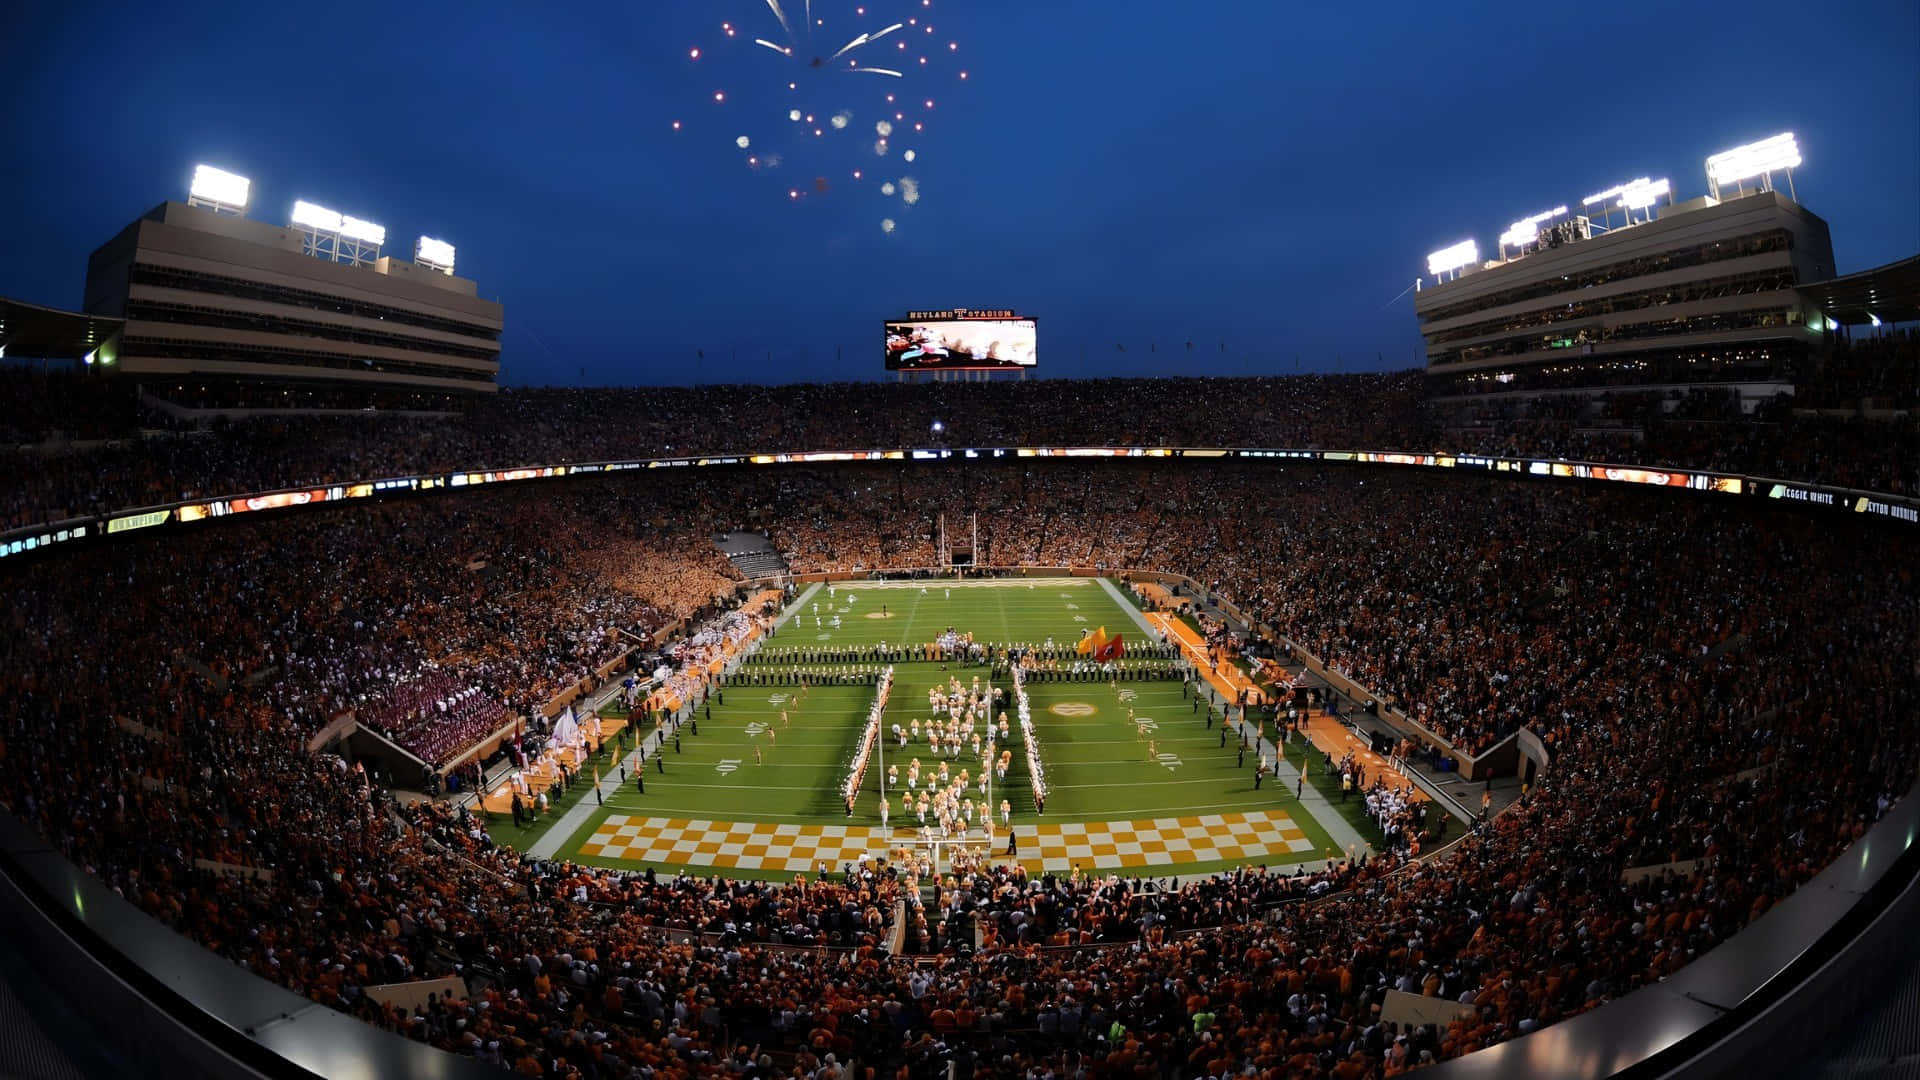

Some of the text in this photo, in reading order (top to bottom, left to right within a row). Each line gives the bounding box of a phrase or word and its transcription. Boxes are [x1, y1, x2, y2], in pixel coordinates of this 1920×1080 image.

[910, 311, 953, 319] NEYLAND
[954, 308, 967, 319] T
[1810, 491, 1833, 505] WHITE
[1891, 505, 1918, 523] MANNING
